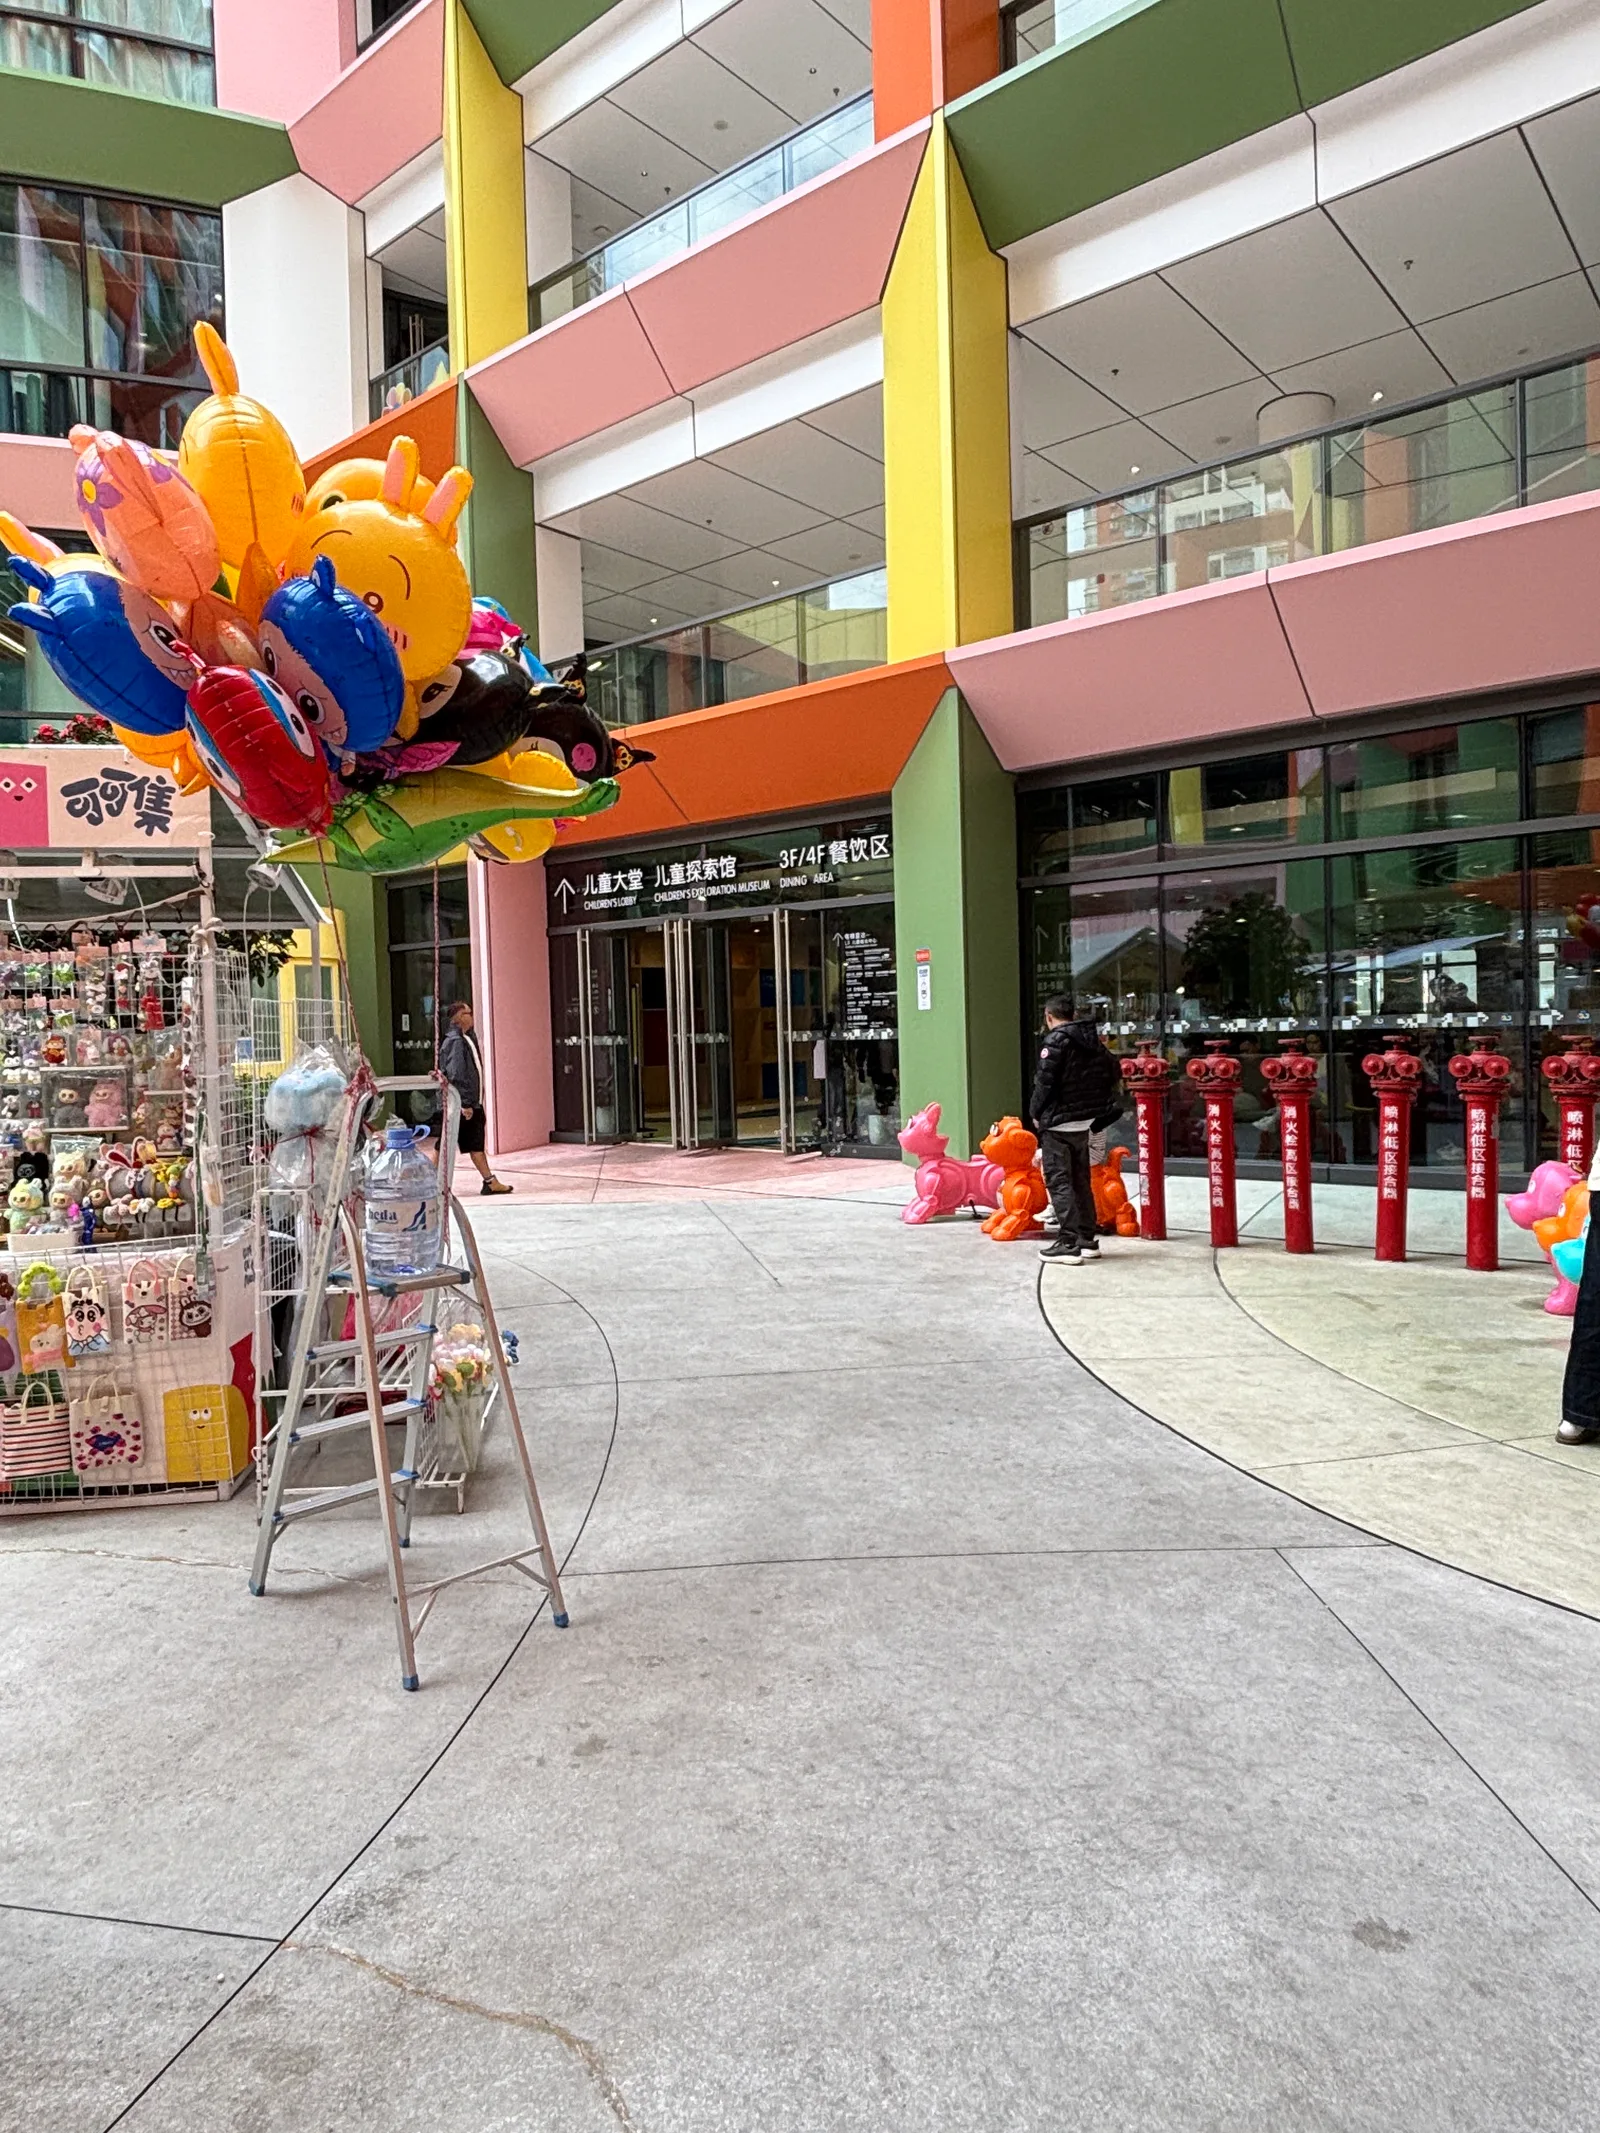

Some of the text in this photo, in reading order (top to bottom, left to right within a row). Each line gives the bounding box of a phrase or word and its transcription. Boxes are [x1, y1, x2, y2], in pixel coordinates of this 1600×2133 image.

[583, 868, 644, 896] 儿童大堂
[653, 854, 737, 888] 儿童探索馆
[779, 871, 834, 888] DINING AREA
[583, 895, 638, 911] CHILDREN'S LOBBY
[653, 879, 771, 903] CHILDREN'S EXPLORATION MUSEUM
[1383, 1105, 1399, 1200] 喷淋低区接合器
[1470, 1108, 1486, 1199] 喷淋低区接合器
